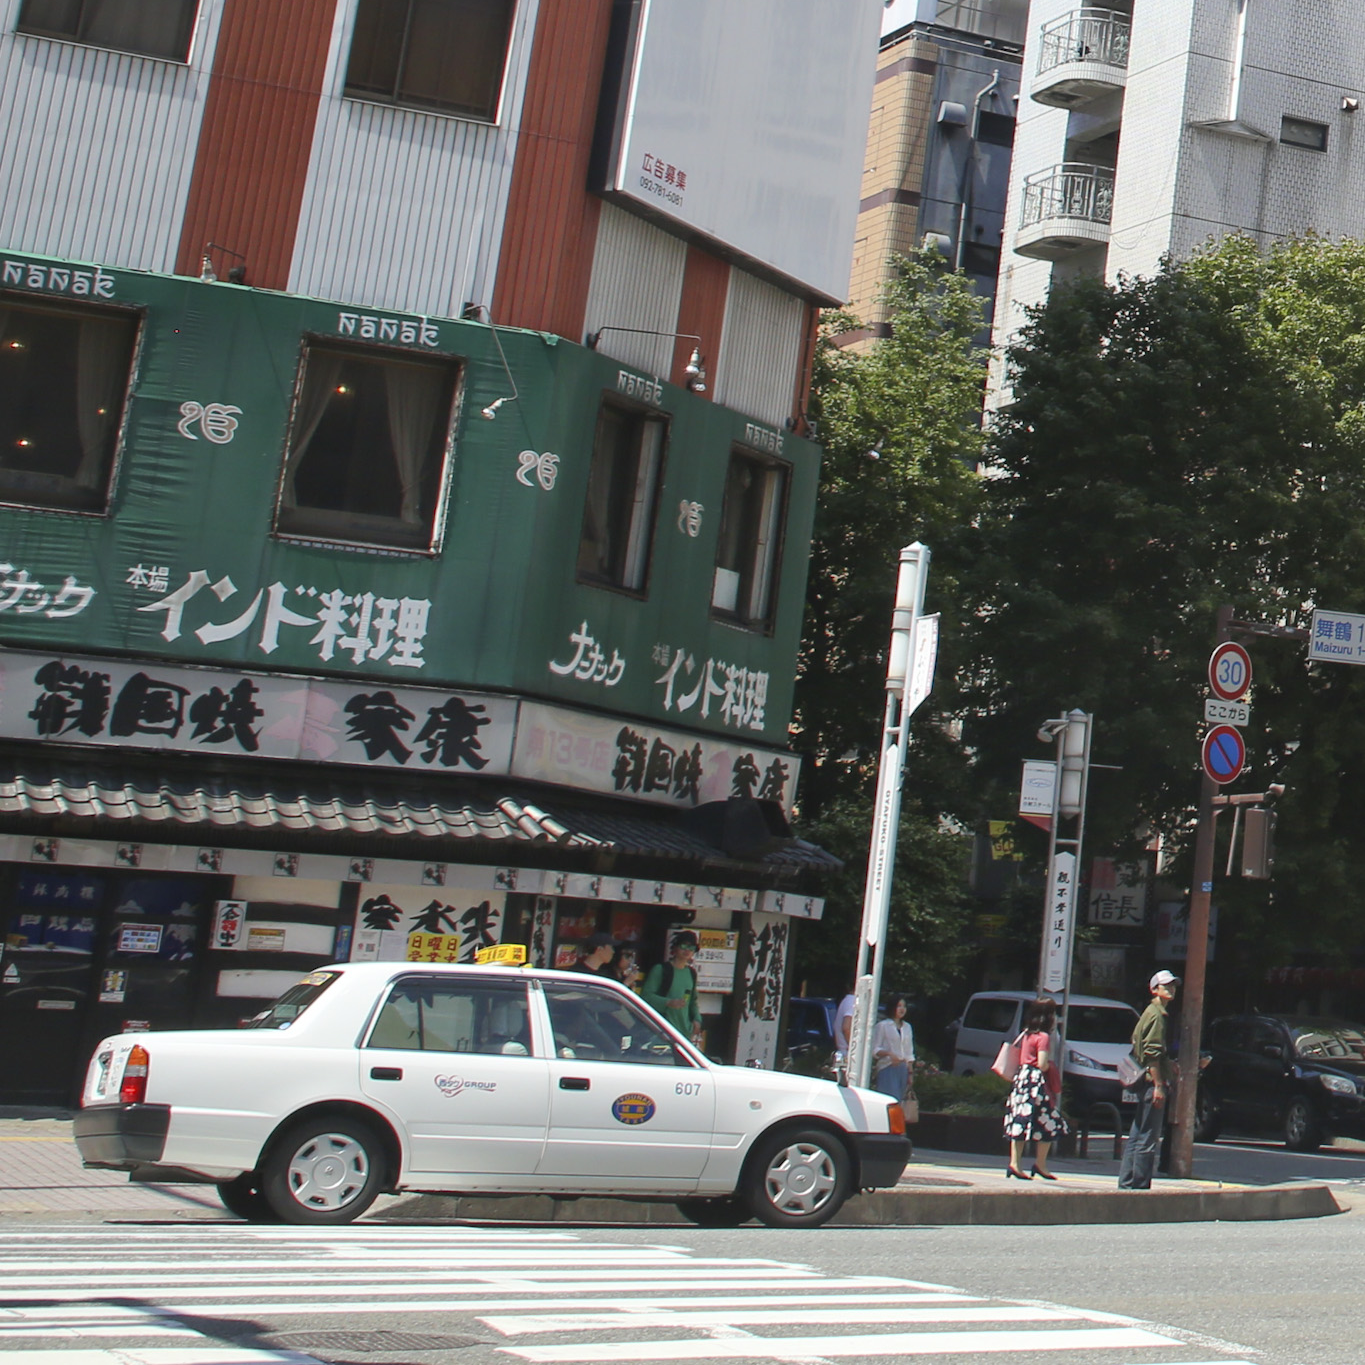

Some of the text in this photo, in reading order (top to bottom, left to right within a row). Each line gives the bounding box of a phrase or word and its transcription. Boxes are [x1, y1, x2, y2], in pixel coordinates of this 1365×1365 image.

[642, 153, 687, 191] 広告募集
[126, 563, 433, 670] 本場 インド料理
[549, 618, 626, 687] ナーナック
[1314, 640, 1353, 657] Maizuru
[1218, 658, 1243, 686] 30
[654, 646, 770, 732] インド料理
[1207, 704, 1248, 722] ここから
[342, 689, 492, 772] 家康
[1053, 871, 1071, 949] 親不孝通り
[1091, 892, 1141, 924] 信長
[411, 935, 458, 951] 日曜日
[464, 1080, 497, 1090] GROUP
[674, 1081, 702, 1097] 607
